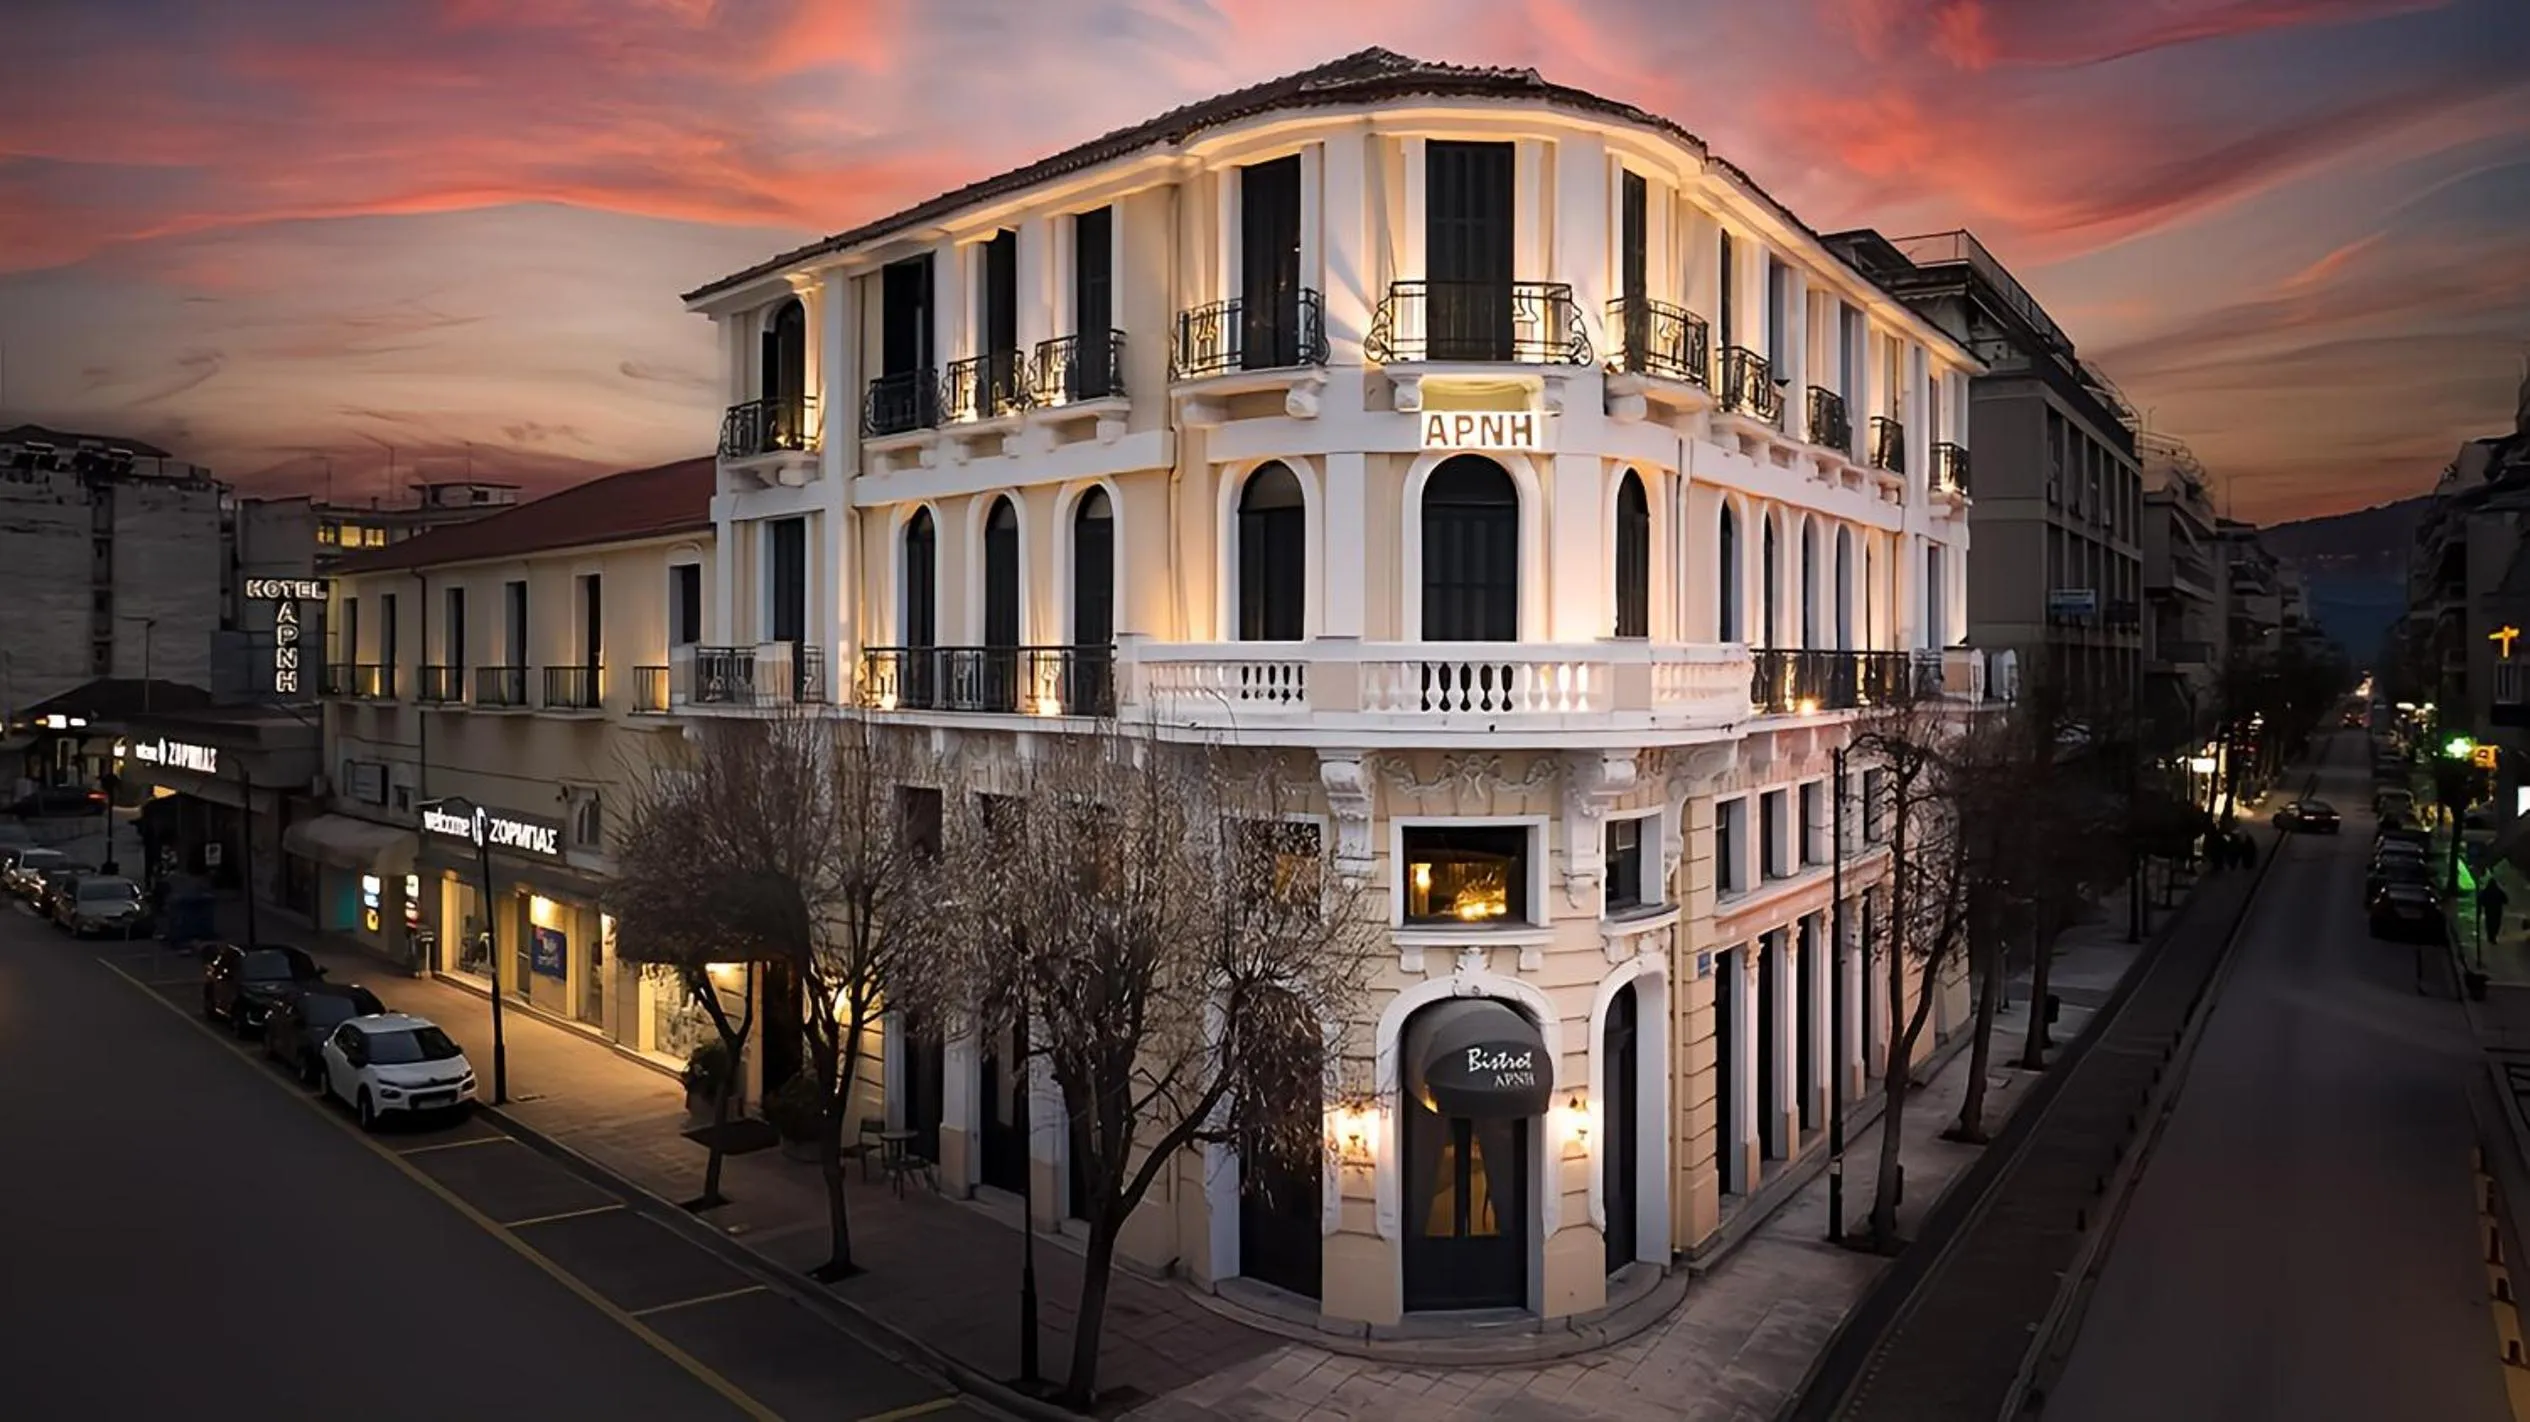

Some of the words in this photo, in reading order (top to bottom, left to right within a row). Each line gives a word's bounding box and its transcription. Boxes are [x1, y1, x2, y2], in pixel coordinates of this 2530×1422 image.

[1424, 414, 1533, 446] ΑΡΝΗ
[276, 601, 299, 692] ΑΡΝΗ
[489, 818, 557, 855] ΖΟΡΜΠΑΣ
[1467, 1047, 1532, 1072] Bistrot
